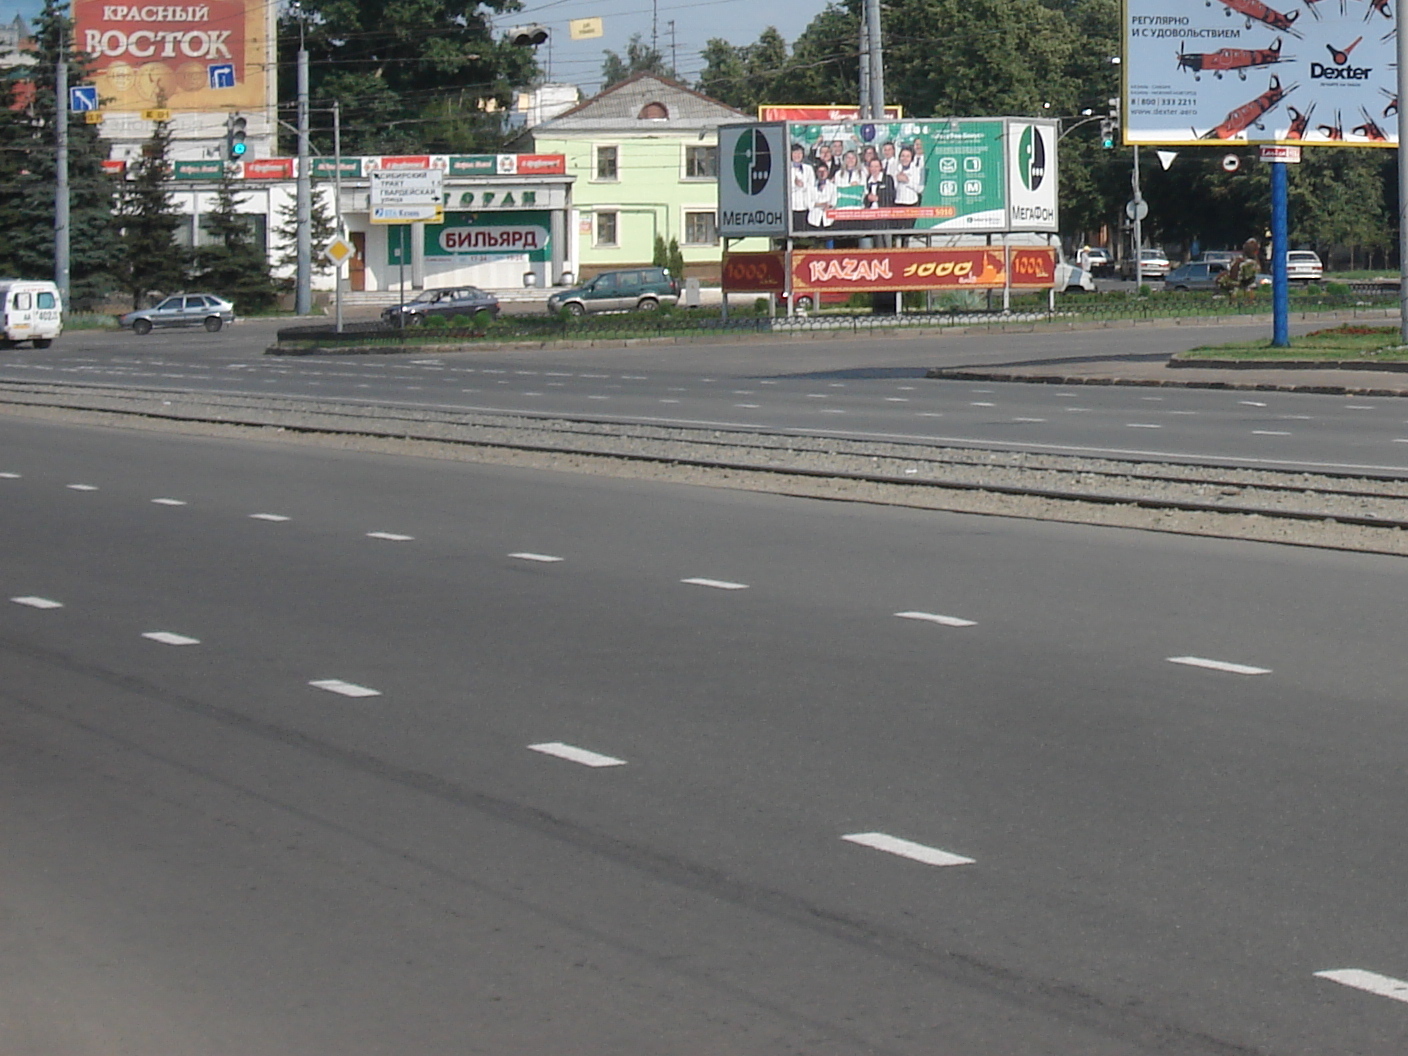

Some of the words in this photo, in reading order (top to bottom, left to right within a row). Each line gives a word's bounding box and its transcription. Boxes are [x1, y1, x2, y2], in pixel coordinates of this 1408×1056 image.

[103, 4, 210, 22] КРАСНЫЙ
[1131, 16, 1190, 25] РЕГУЛЯРНО
[1132, 29, 1140, 37] И
[1142, 29, 1149, 37] С
[1151, 29, 1240, 38] УДОВОЛЬСТВИЕМ
[85, 29, 232, 59] ВОСТОК
[1310, 62, 1373, 80] Dexter
[445, 230, 538, 249] БИЛЬЯРД
[809, 258, 893, 282] KAZAN
